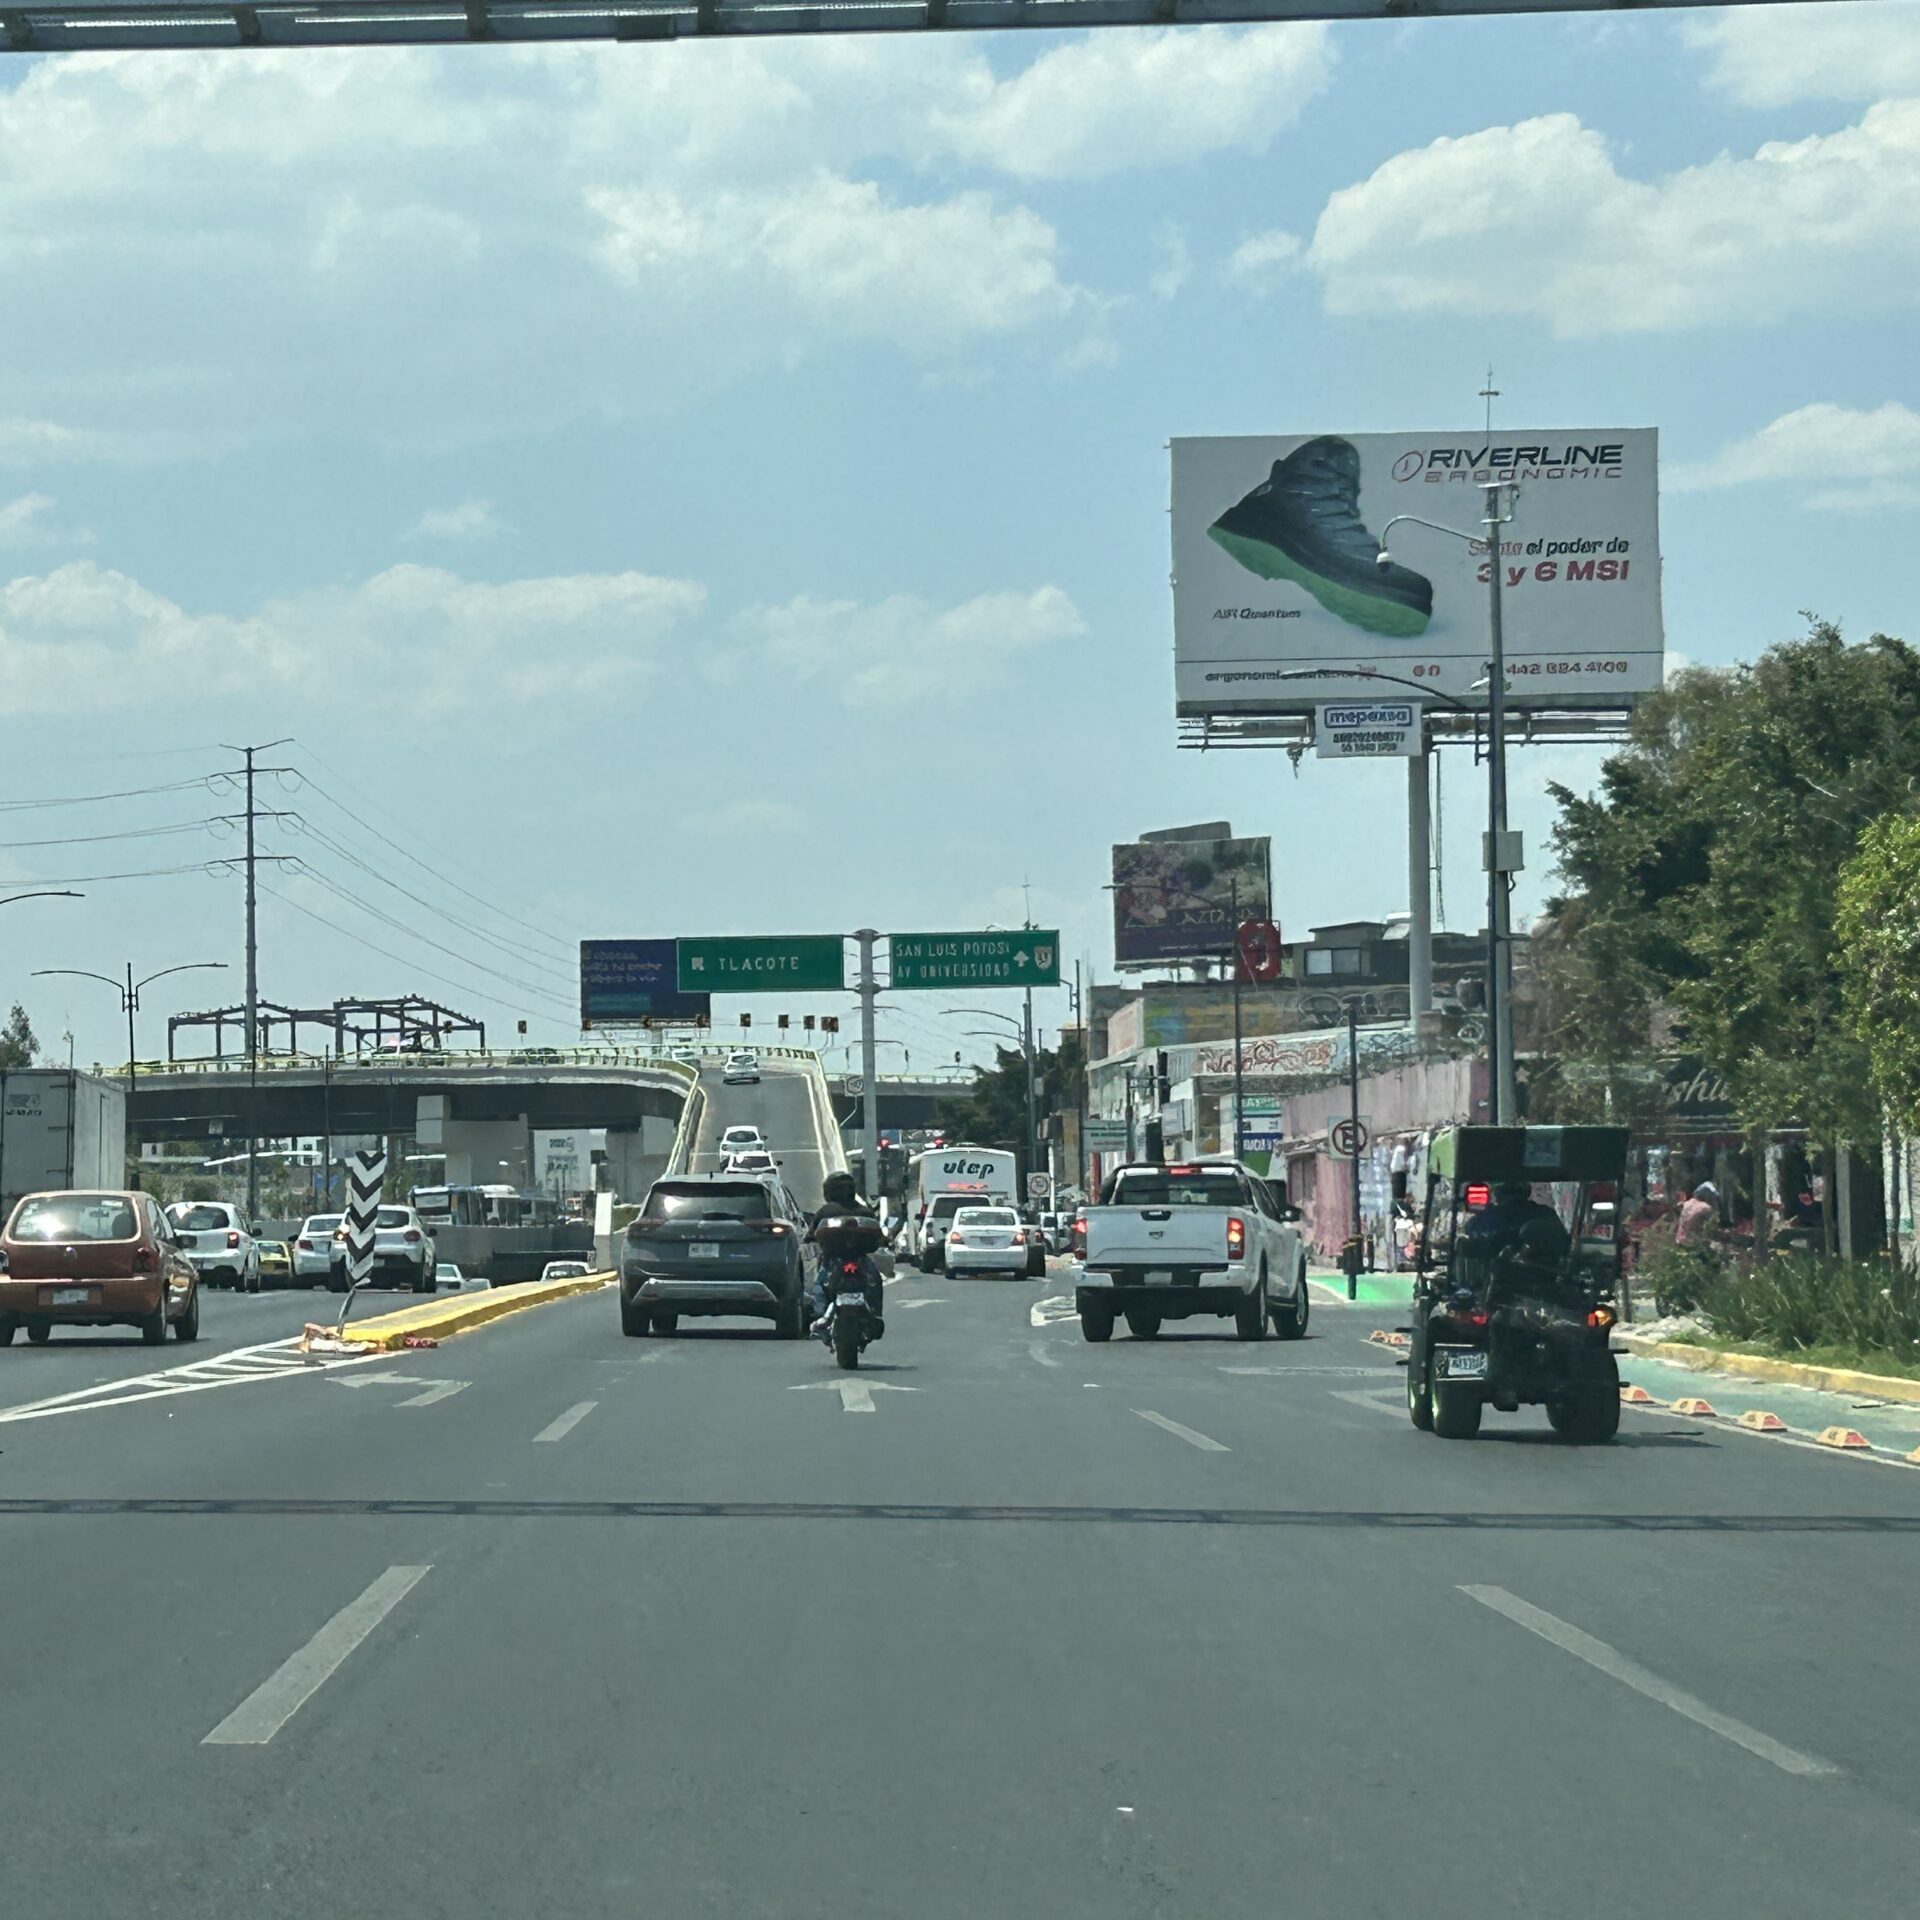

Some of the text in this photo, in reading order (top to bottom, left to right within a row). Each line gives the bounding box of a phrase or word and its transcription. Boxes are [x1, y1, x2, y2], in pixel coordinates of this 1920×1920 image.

[1428, 445, 1623, 468] RIVERLINE
[1526, 538, 1544, 555] el
[1546, 537, 1603, 557] poder
[1606, 537, 1629, 553] de
[1506, 566, 1527, 587] y
[1535, 561, 1557, 581] 6
[1566, 560, 1629, 581] MSI
[896, 944, 921, 957] SAN
[928, 943, 957, 957] LUIS
[719, 957, 799, 970] TLACOTE
[897, 963, 1010, 978] AV UNIVERSIDAD
